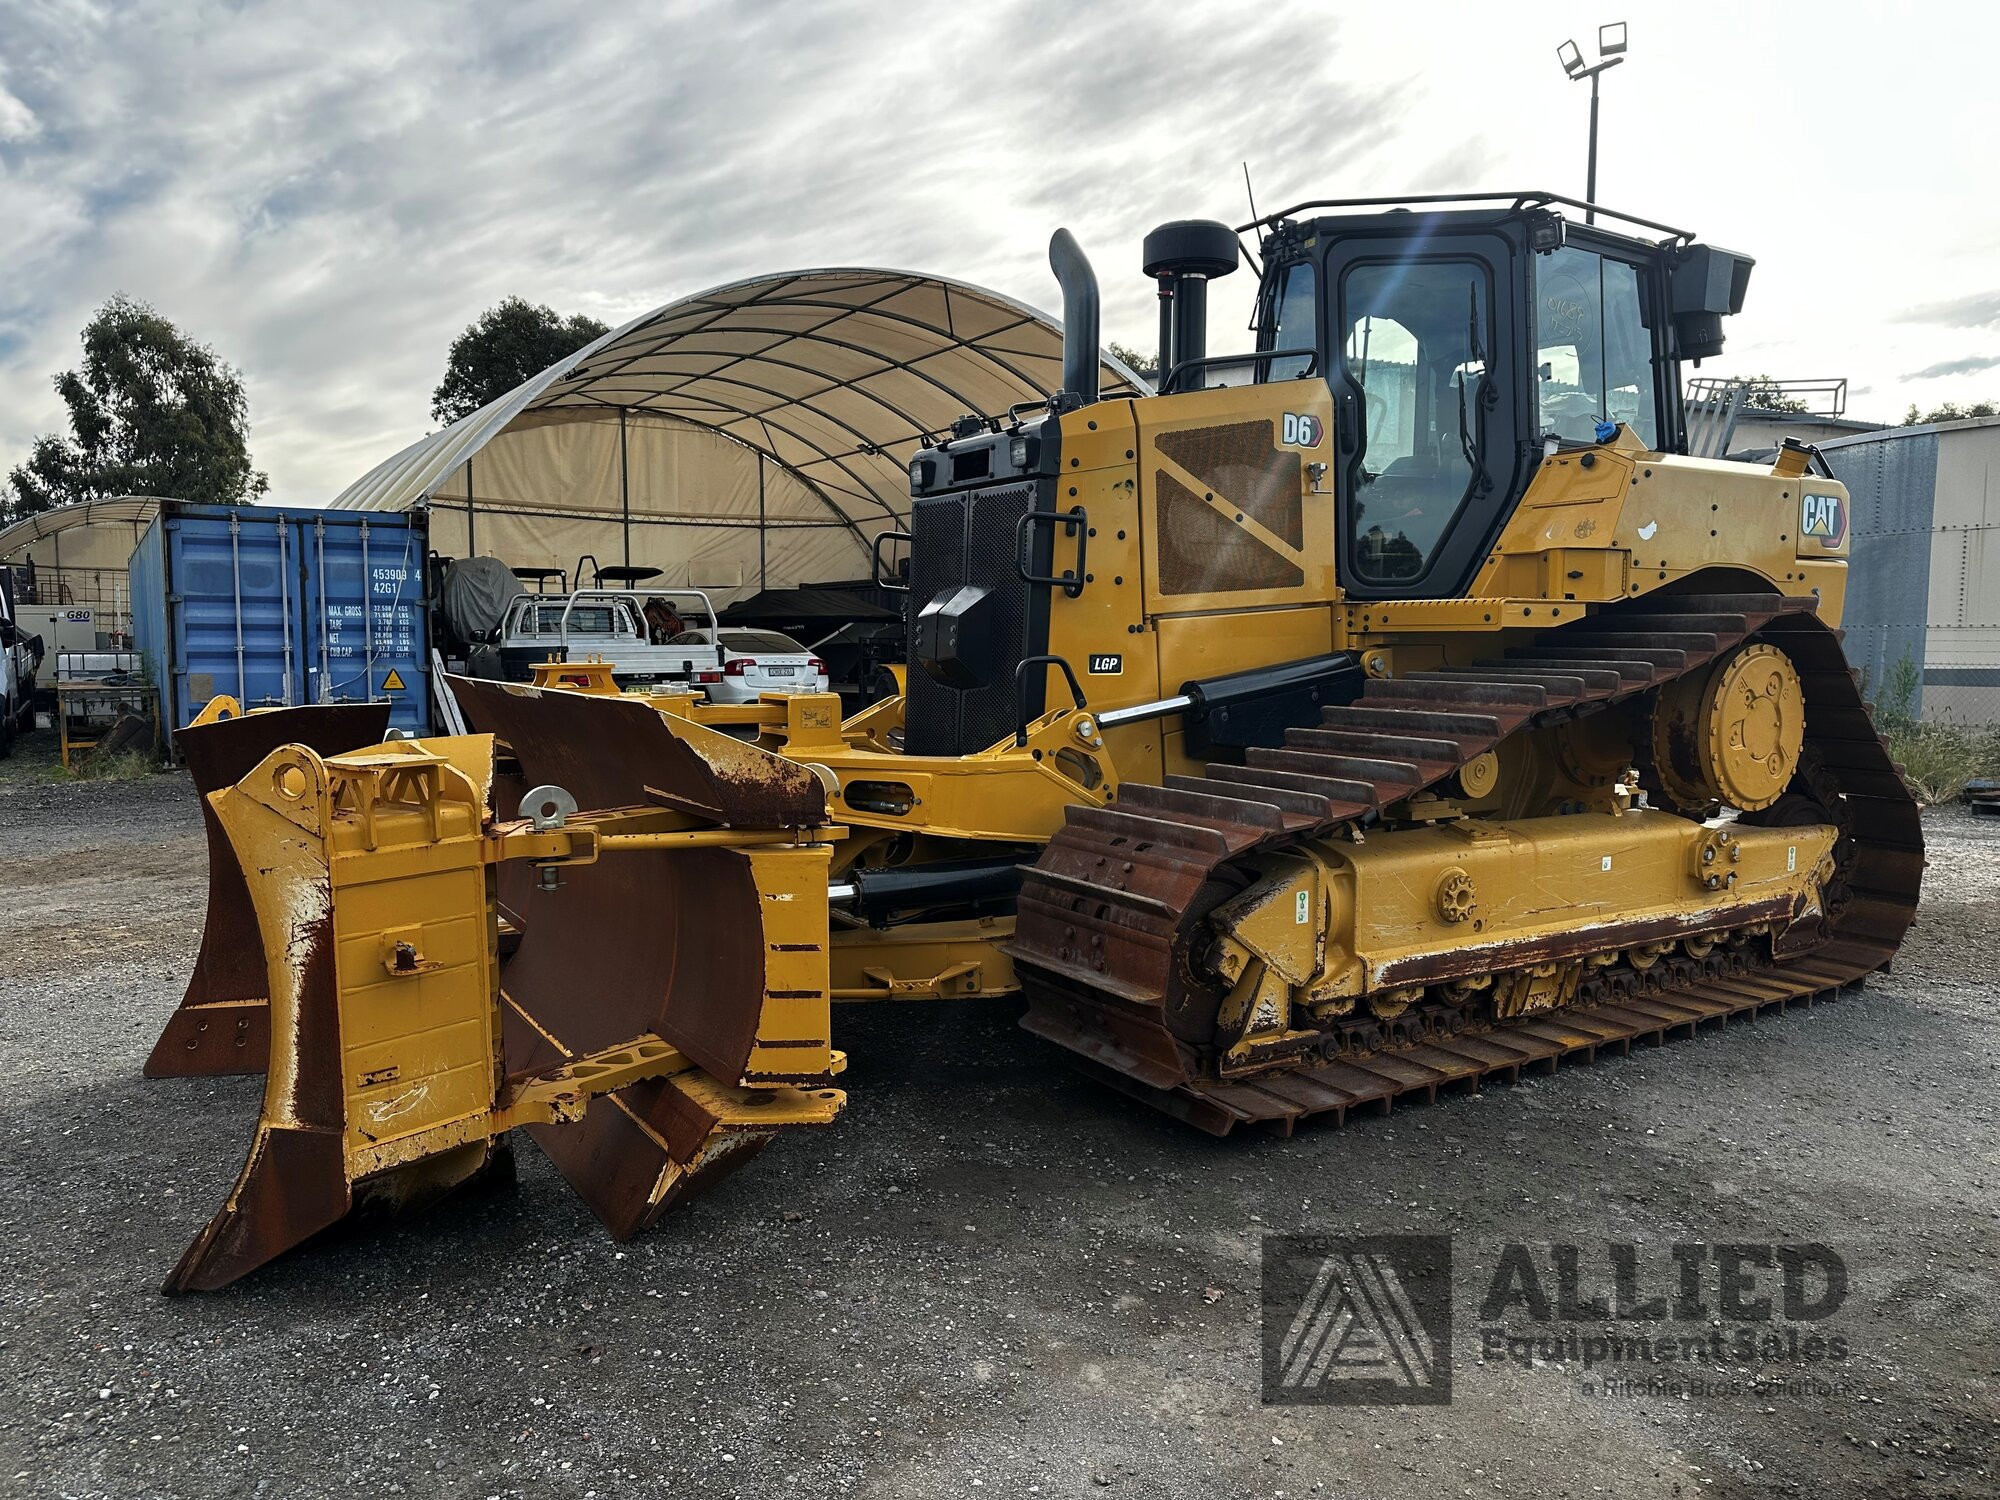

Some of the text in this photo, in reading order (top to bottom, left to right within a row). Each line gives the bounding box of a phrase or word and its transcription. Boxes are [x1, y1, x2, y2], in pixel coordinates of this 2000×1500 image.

[1282, 413, 1312, 446] D6
[1802, 495, 1838, 536] CAT
[414, 569, 422, 582] 4
[374, 583, 396, 594] 42G1
[67, 610, 91, 620] G80
[344, 606, 362, 617] GROSS
[329, 633, 339, 644] NET
[1094, 657, 1118, 671] LGP
